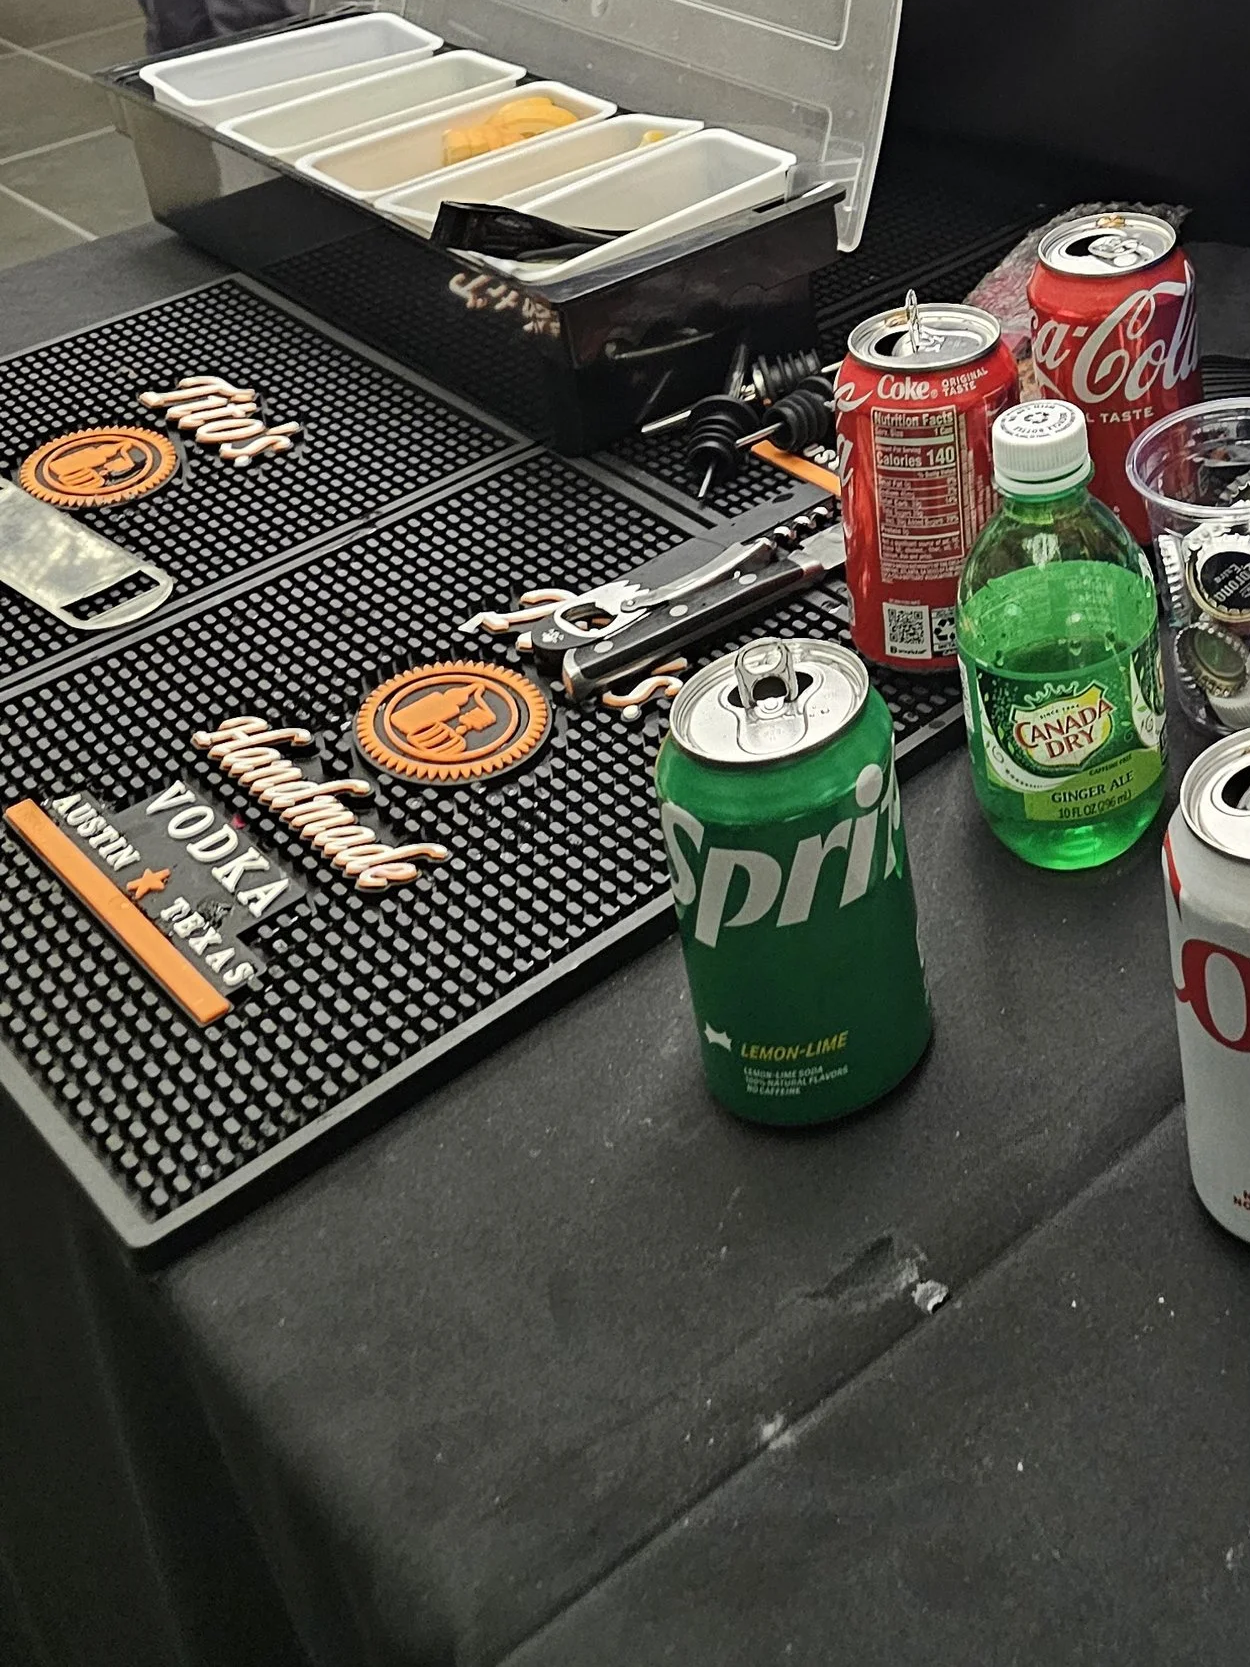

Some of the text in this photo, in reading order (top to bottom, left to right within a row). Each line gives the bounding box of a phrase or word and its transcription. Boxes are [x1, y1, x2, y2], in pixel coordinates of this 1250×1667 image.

[877, 374, 930, 400] Coke
[942, 367, 988, 388] ORIGINAL
[942, 381, 977, 397] TASTE
[874, 410, 954, 427] Nutrition Facts
[1099, 406, 1154, 424] TASTE
[876, 446, 955, 468] Calories 140
[1014, 698, 1113, 749] CANADA
[1045, 725, 1095, 759] DRY
[1051, 770, 1134, 803] GINGER ALE
[192, 715, 449, 891] Handmade
[1059, 809, 1071, 819] 10
[1072, 807, 1082, 818] FL
[1084, 804, 1096, 816] OZ
[145, 780, 290, 917] VODKA
[52, 792, 257, 986] AUSTIN TEXAS
[741, 1030, 849, 1061] LEMON-LIME
